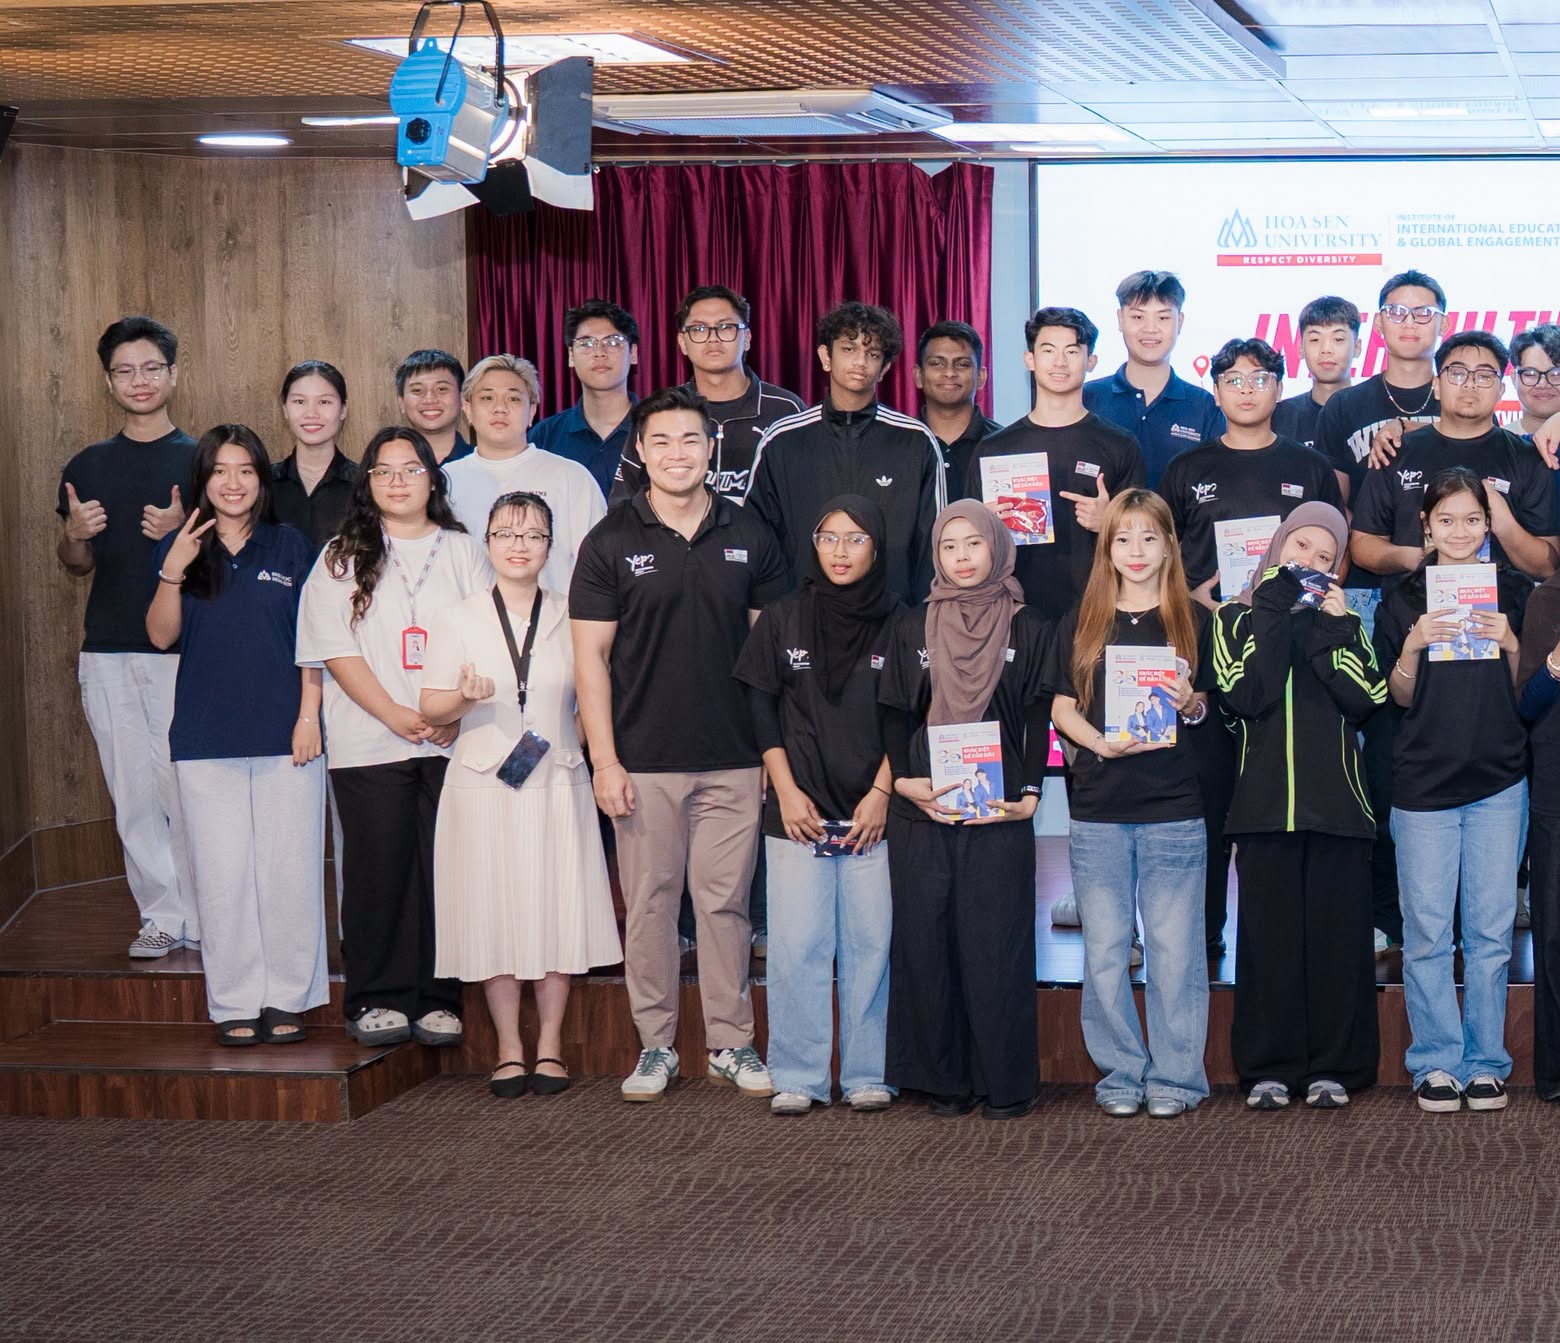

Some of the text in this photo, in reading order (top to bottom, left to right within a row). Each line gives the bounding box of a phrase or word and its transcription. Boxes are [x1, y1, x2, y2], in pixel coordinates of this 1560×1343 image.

[1265, 215, 1349, 229] HOA SEN
[1397, 213, 1456, 221] INSTITUTE OF
[1397, 223, 1503, 234] INTERNATIONAL
[1265, 232, 1382, 248] UNIVERSITY
[1397, 236, 1560, 248] & GLOBAL ENGAGEMENT
[1243, 255, 1356, 265] RESPECT DIVERSITY
